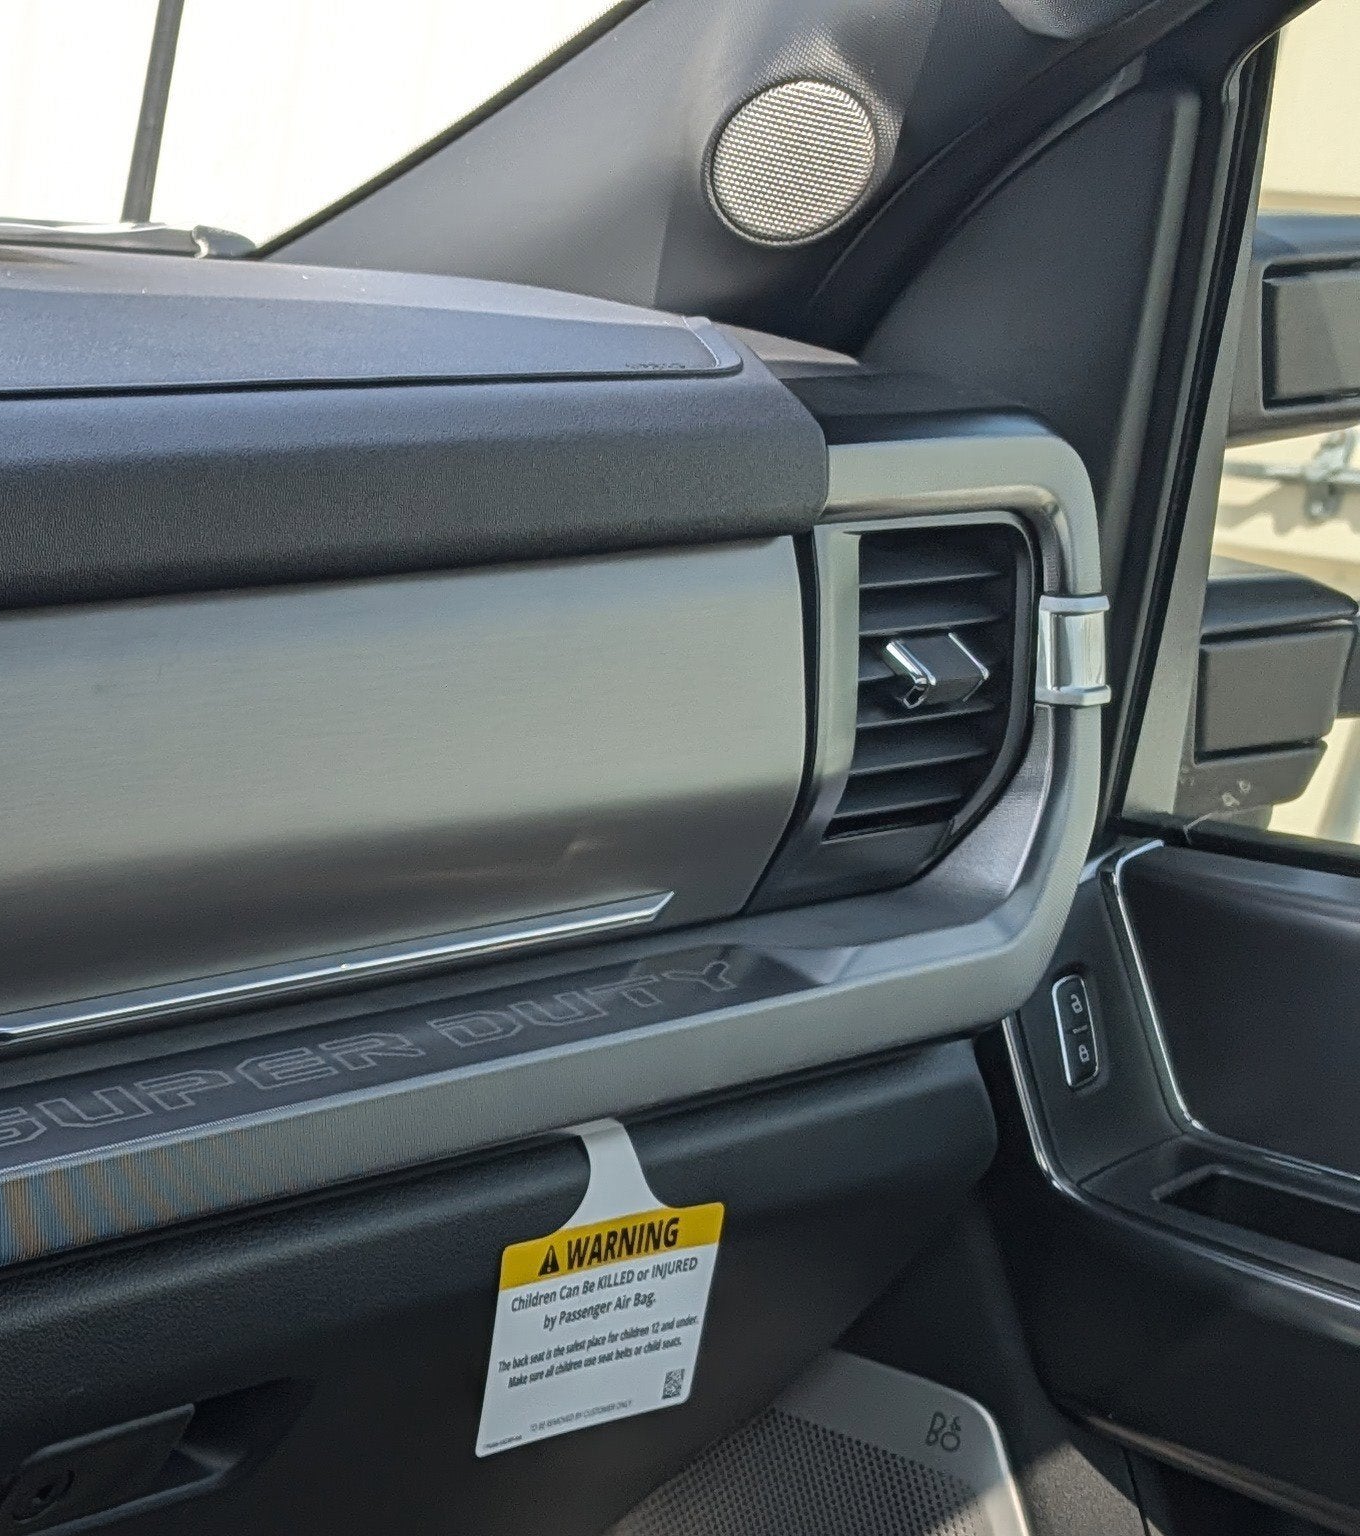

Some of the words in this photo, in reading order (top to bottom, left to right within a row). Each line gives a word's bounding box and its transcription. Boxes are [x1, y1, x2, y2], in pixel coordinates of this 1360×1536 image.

[428, 960, 738, 1054] DUTY
[567, 1217, 680, 1270] WARNING
[511, 1289, 556, 1312] Children
[560, 1285, 579, 1301] Can
[582, 1280, 594, 1294] Be
[597, 1269, 634, 1290] KILLED
[637, 1267, 649, 1281] or
[651, 1256, 698, 1280] INJURED
[543, 1314, 557, 1331] by
[559, 1301, 611, 1326] Passenger
[614, 1295, 631, 1311] Air
